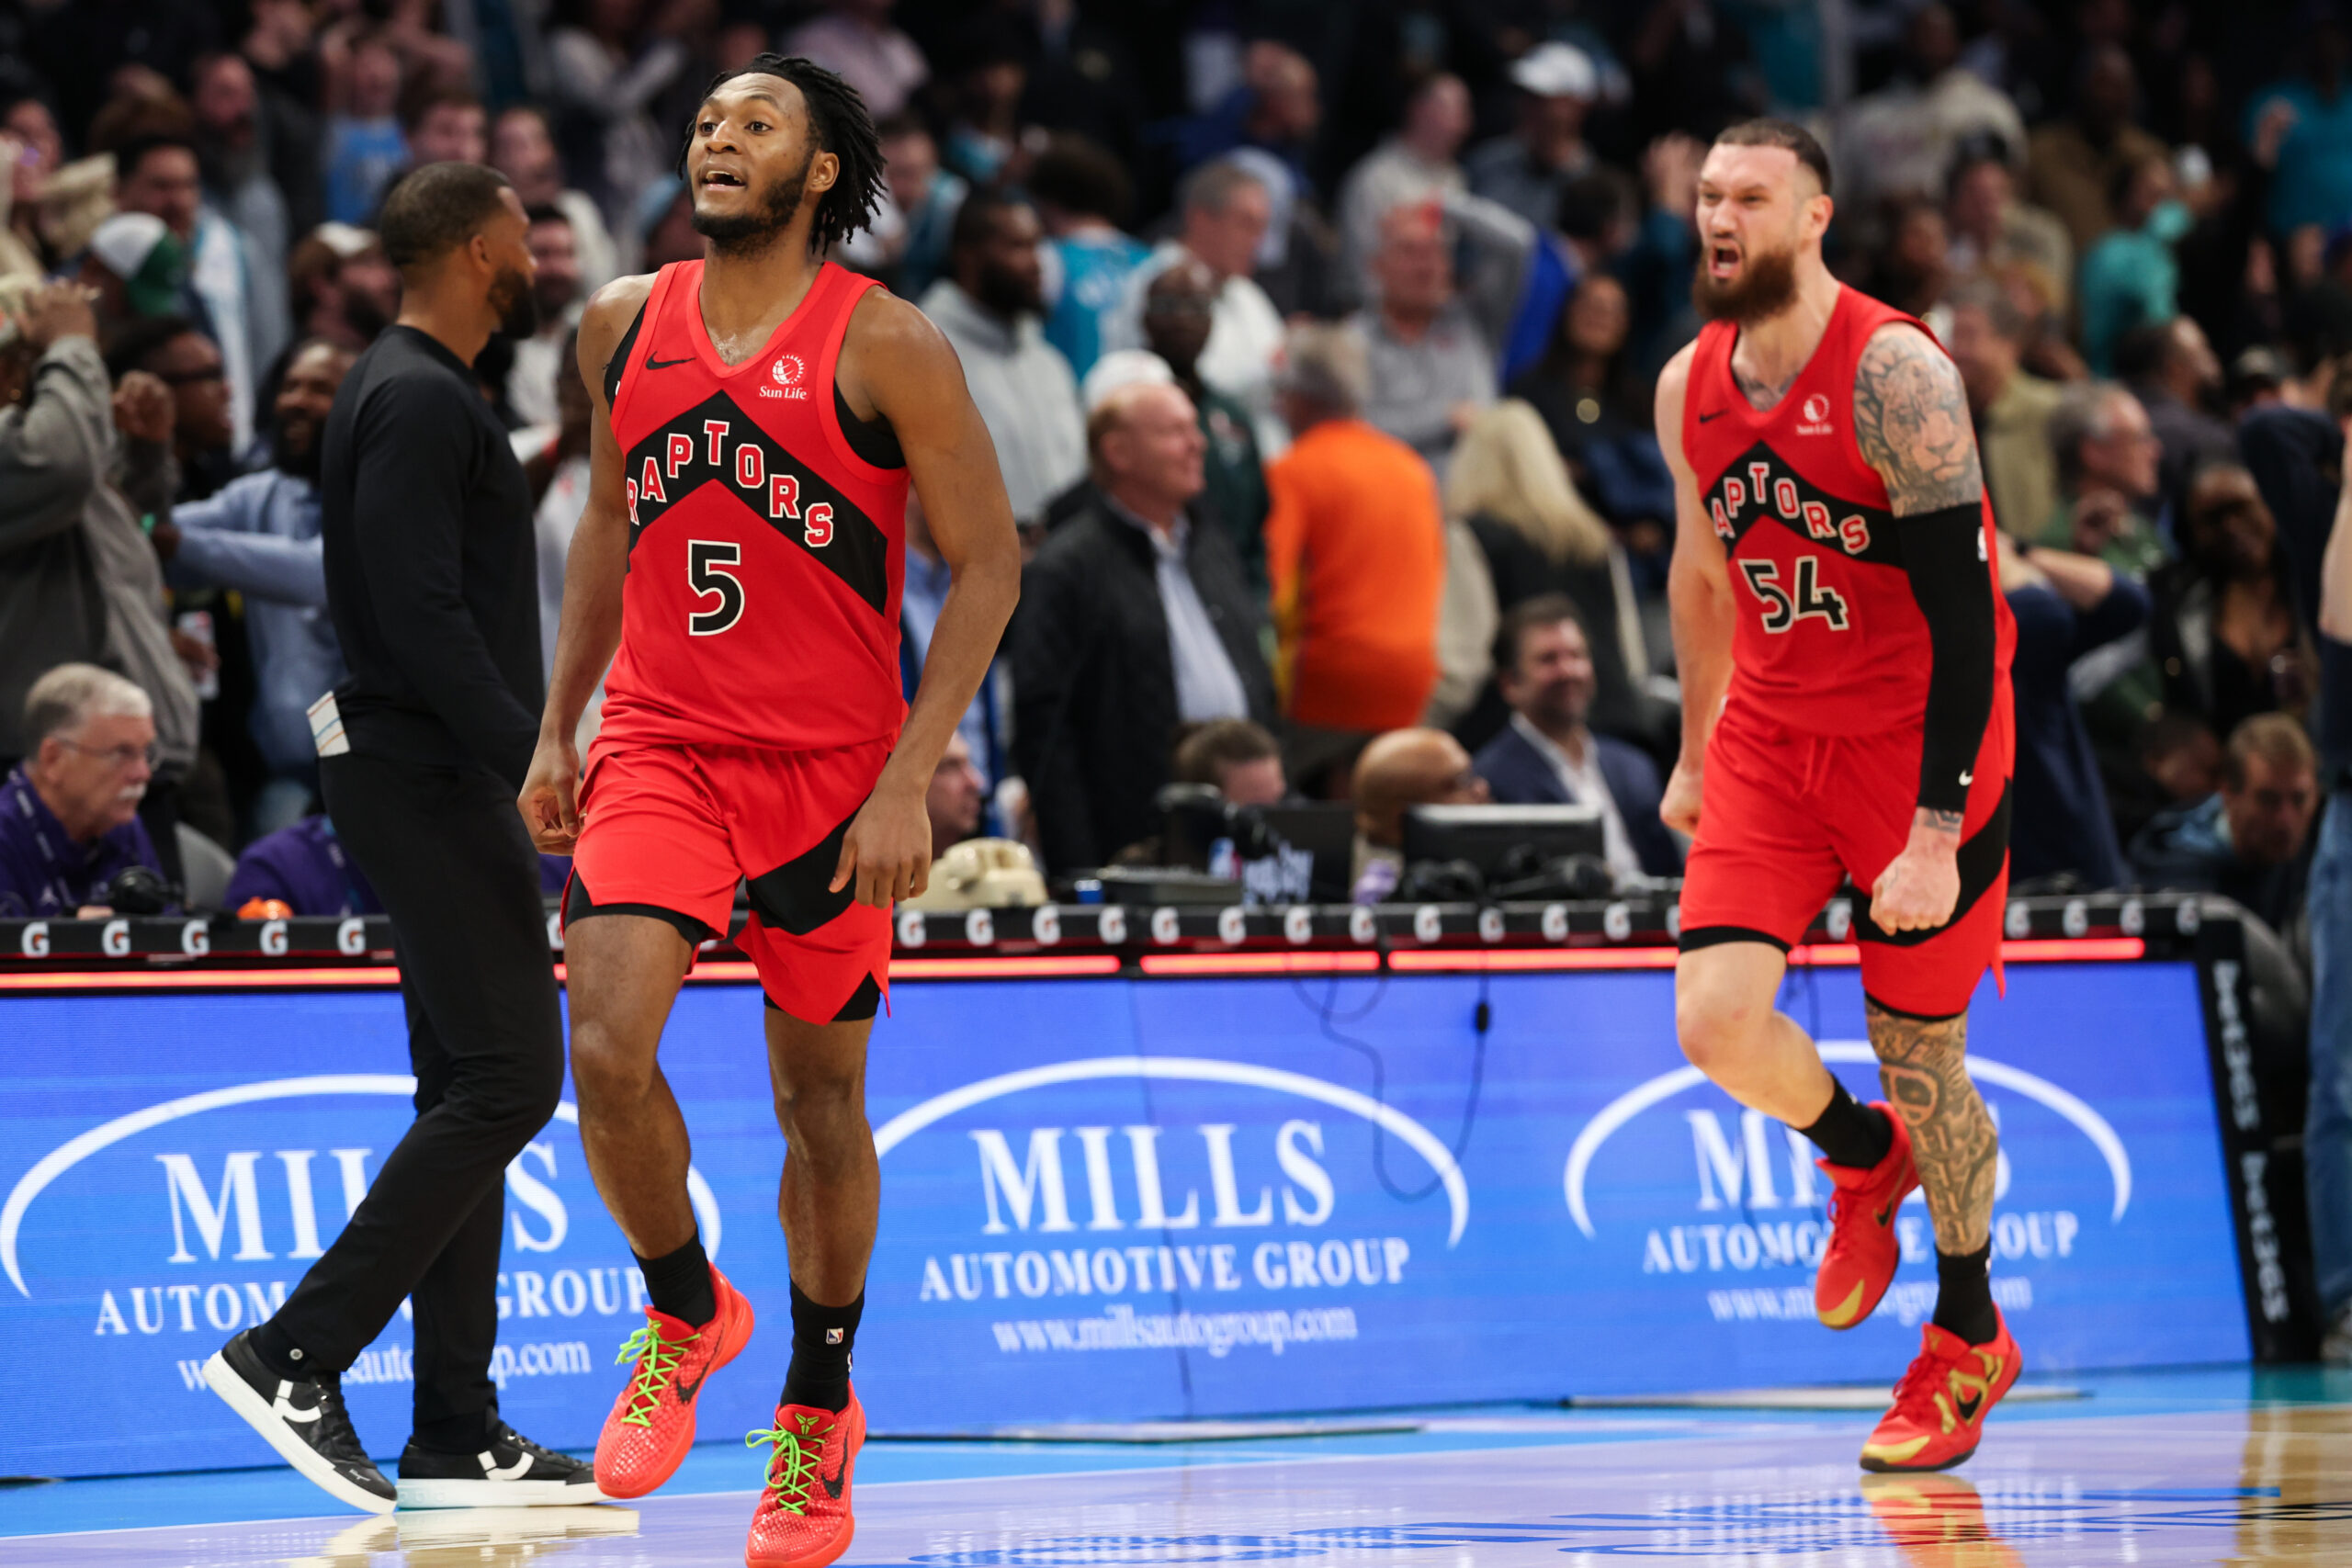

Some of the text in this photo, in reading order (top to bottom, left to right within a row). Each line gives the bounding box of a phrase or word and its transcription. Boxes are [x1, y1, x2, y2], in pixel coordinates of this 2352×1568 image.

[759, 385, 808, 400] Sun Life
[627, 419, 833, 547] RAPTORS
[1712, 462, 1871, 555] APTORS
[687, 538, 745, 637] 5
[1738, 556, 1849, 634] 54
[21, 922, 49, 957] G
[102, 920, 130, 956] G
[182, 920, 209, 956] G
[260, 919, 288, 955] G
[338, 918, 366, 955] G
[154, 1140, 568, 1263] MIS
[967, 1120, 1335, 1235] MILLS
[920, 1237, 1410, 1302] AUTOMOTIVE GROUP
[1643, 1219, 1928, 1275] AUTOMOE
[992, 1303, 1359, 1359] www.millsautogroup.com
